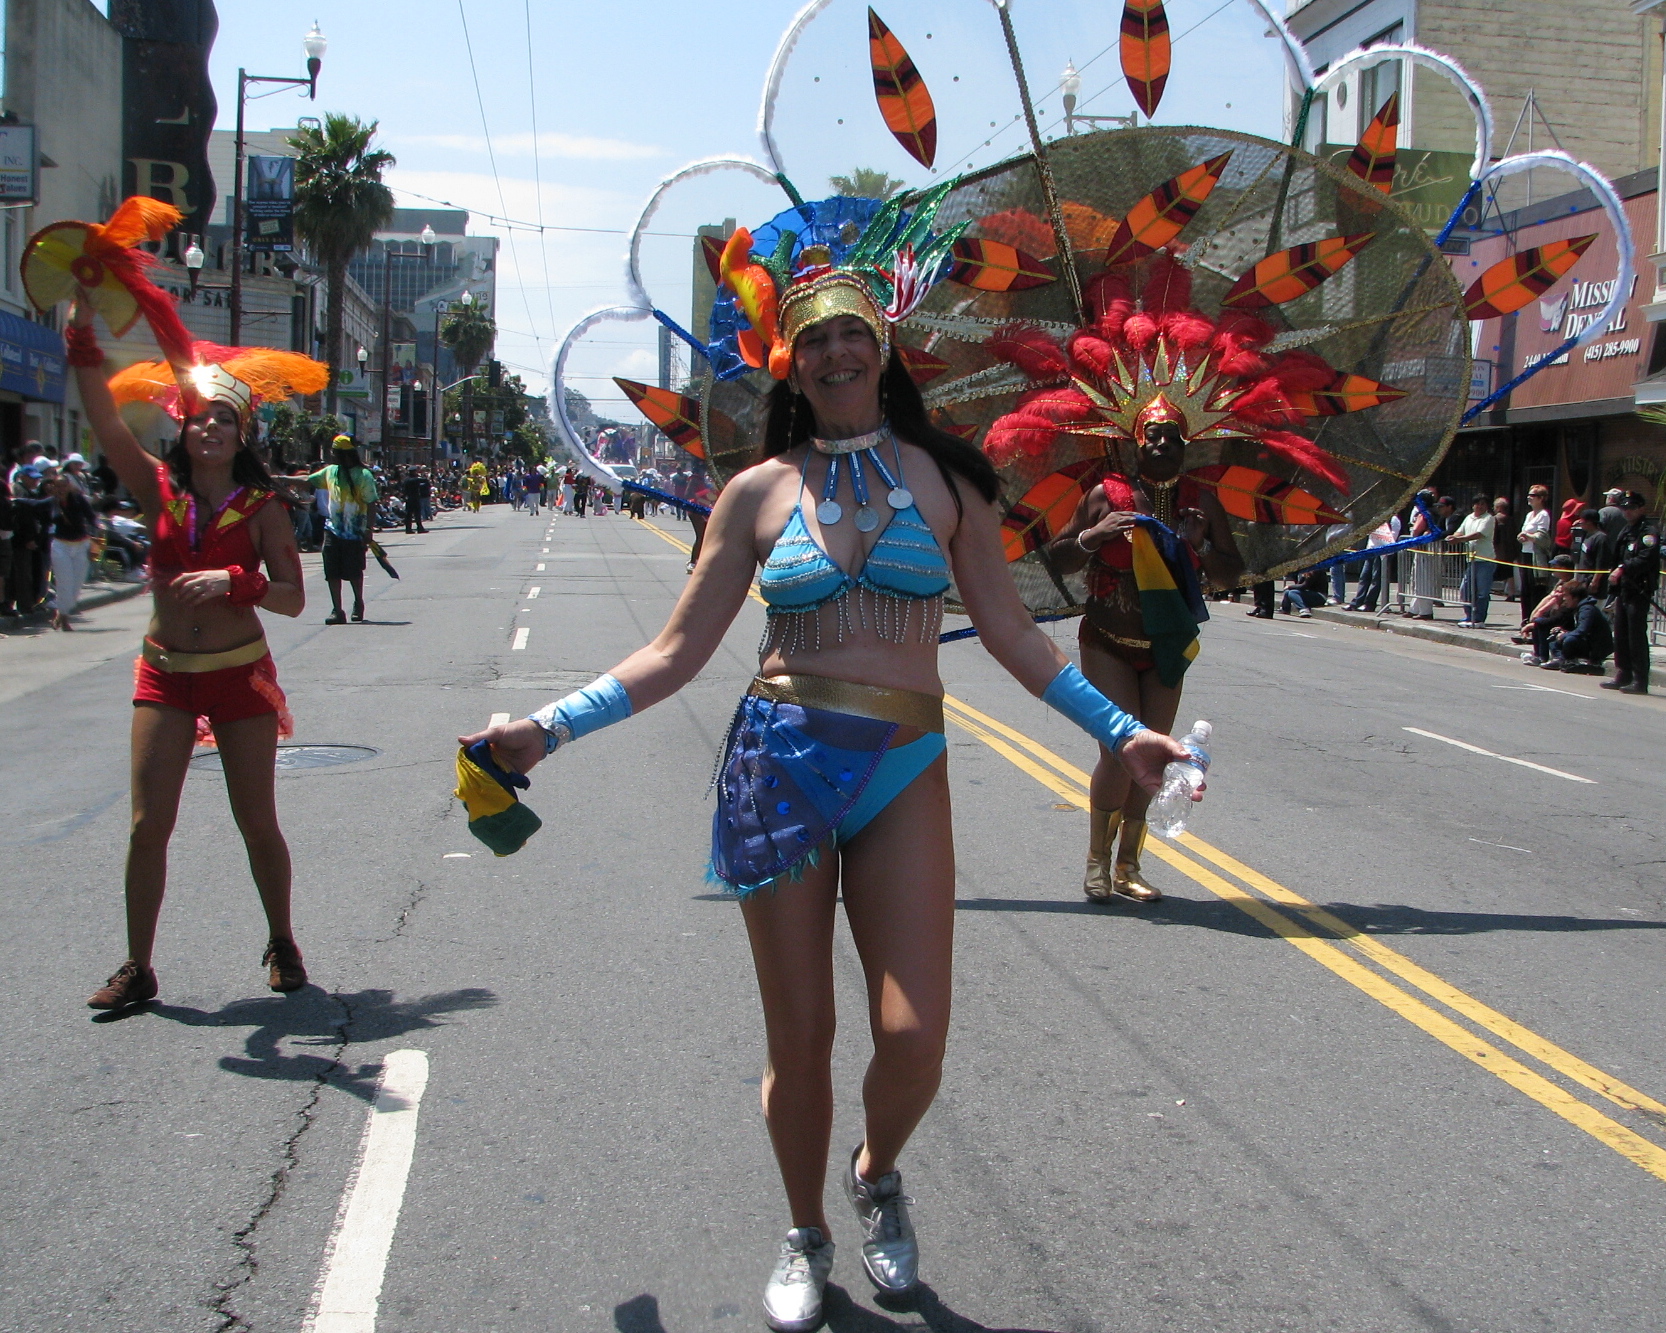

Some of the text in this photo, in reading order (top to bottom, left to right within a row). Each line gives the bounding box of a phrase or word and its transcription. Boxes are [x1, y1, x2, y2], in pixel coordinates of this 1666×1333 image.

[1570, 275, 1638, 309] MISSIN
[1583, 339, 1639, 363] (415) 285-9900
